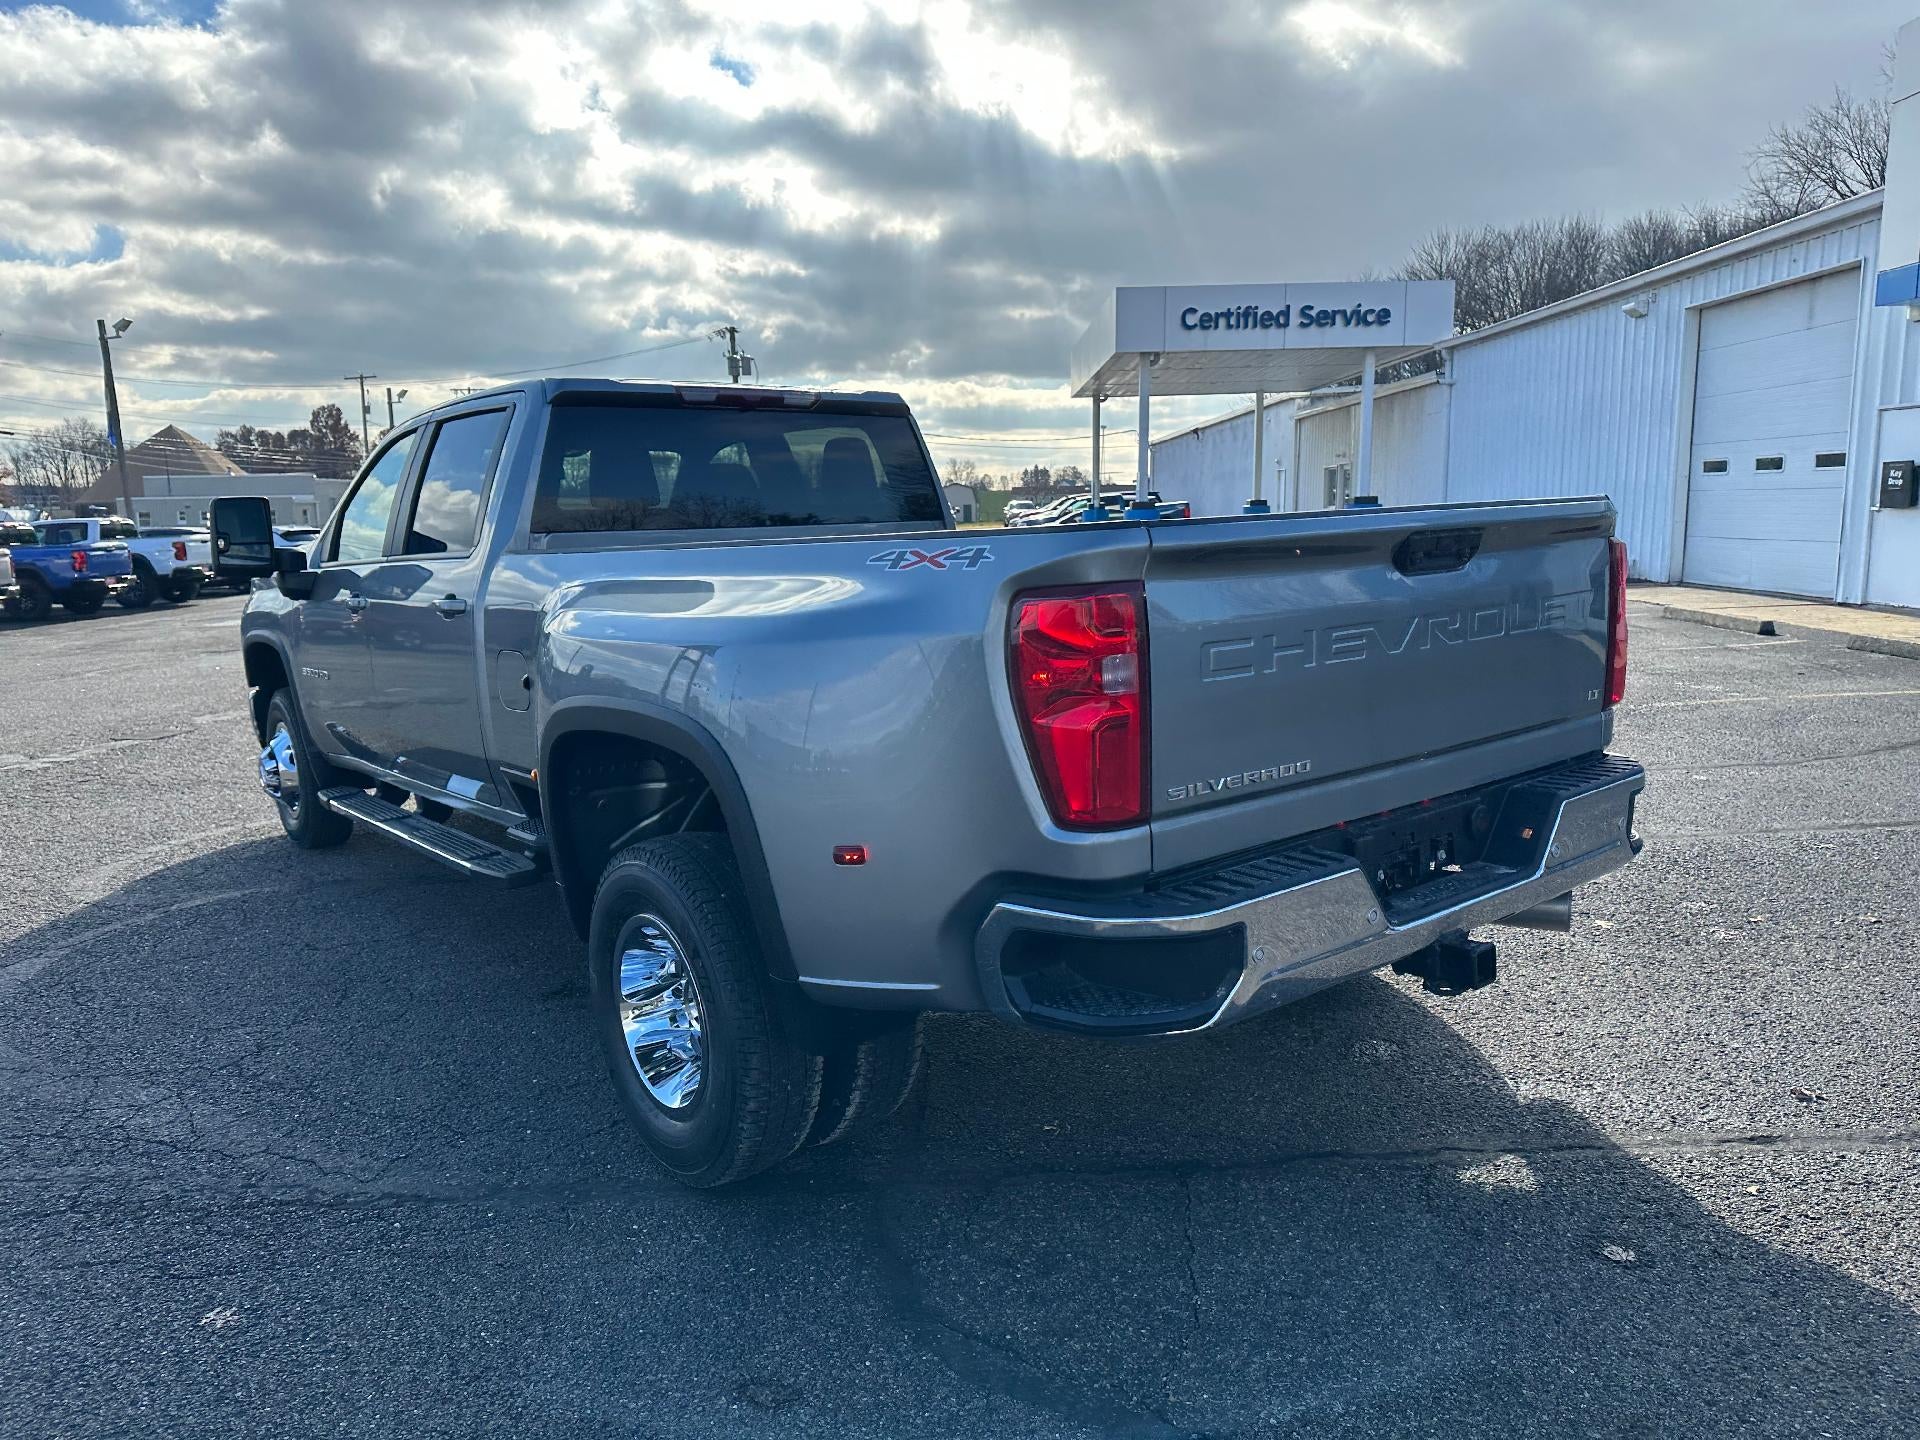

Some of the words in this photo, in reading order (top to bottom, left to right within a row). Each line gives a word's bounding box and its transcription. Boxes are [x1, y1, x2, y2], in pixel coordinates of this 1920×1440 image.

[1181, 304, 1291, 330] Certified
[1298, 302, 1392, 328] Service
[1888, 478, 1903, 486] Drop
[1890, 470, 1903, 478] Key
[1167, 759, 1312, 801] SILVERADO
